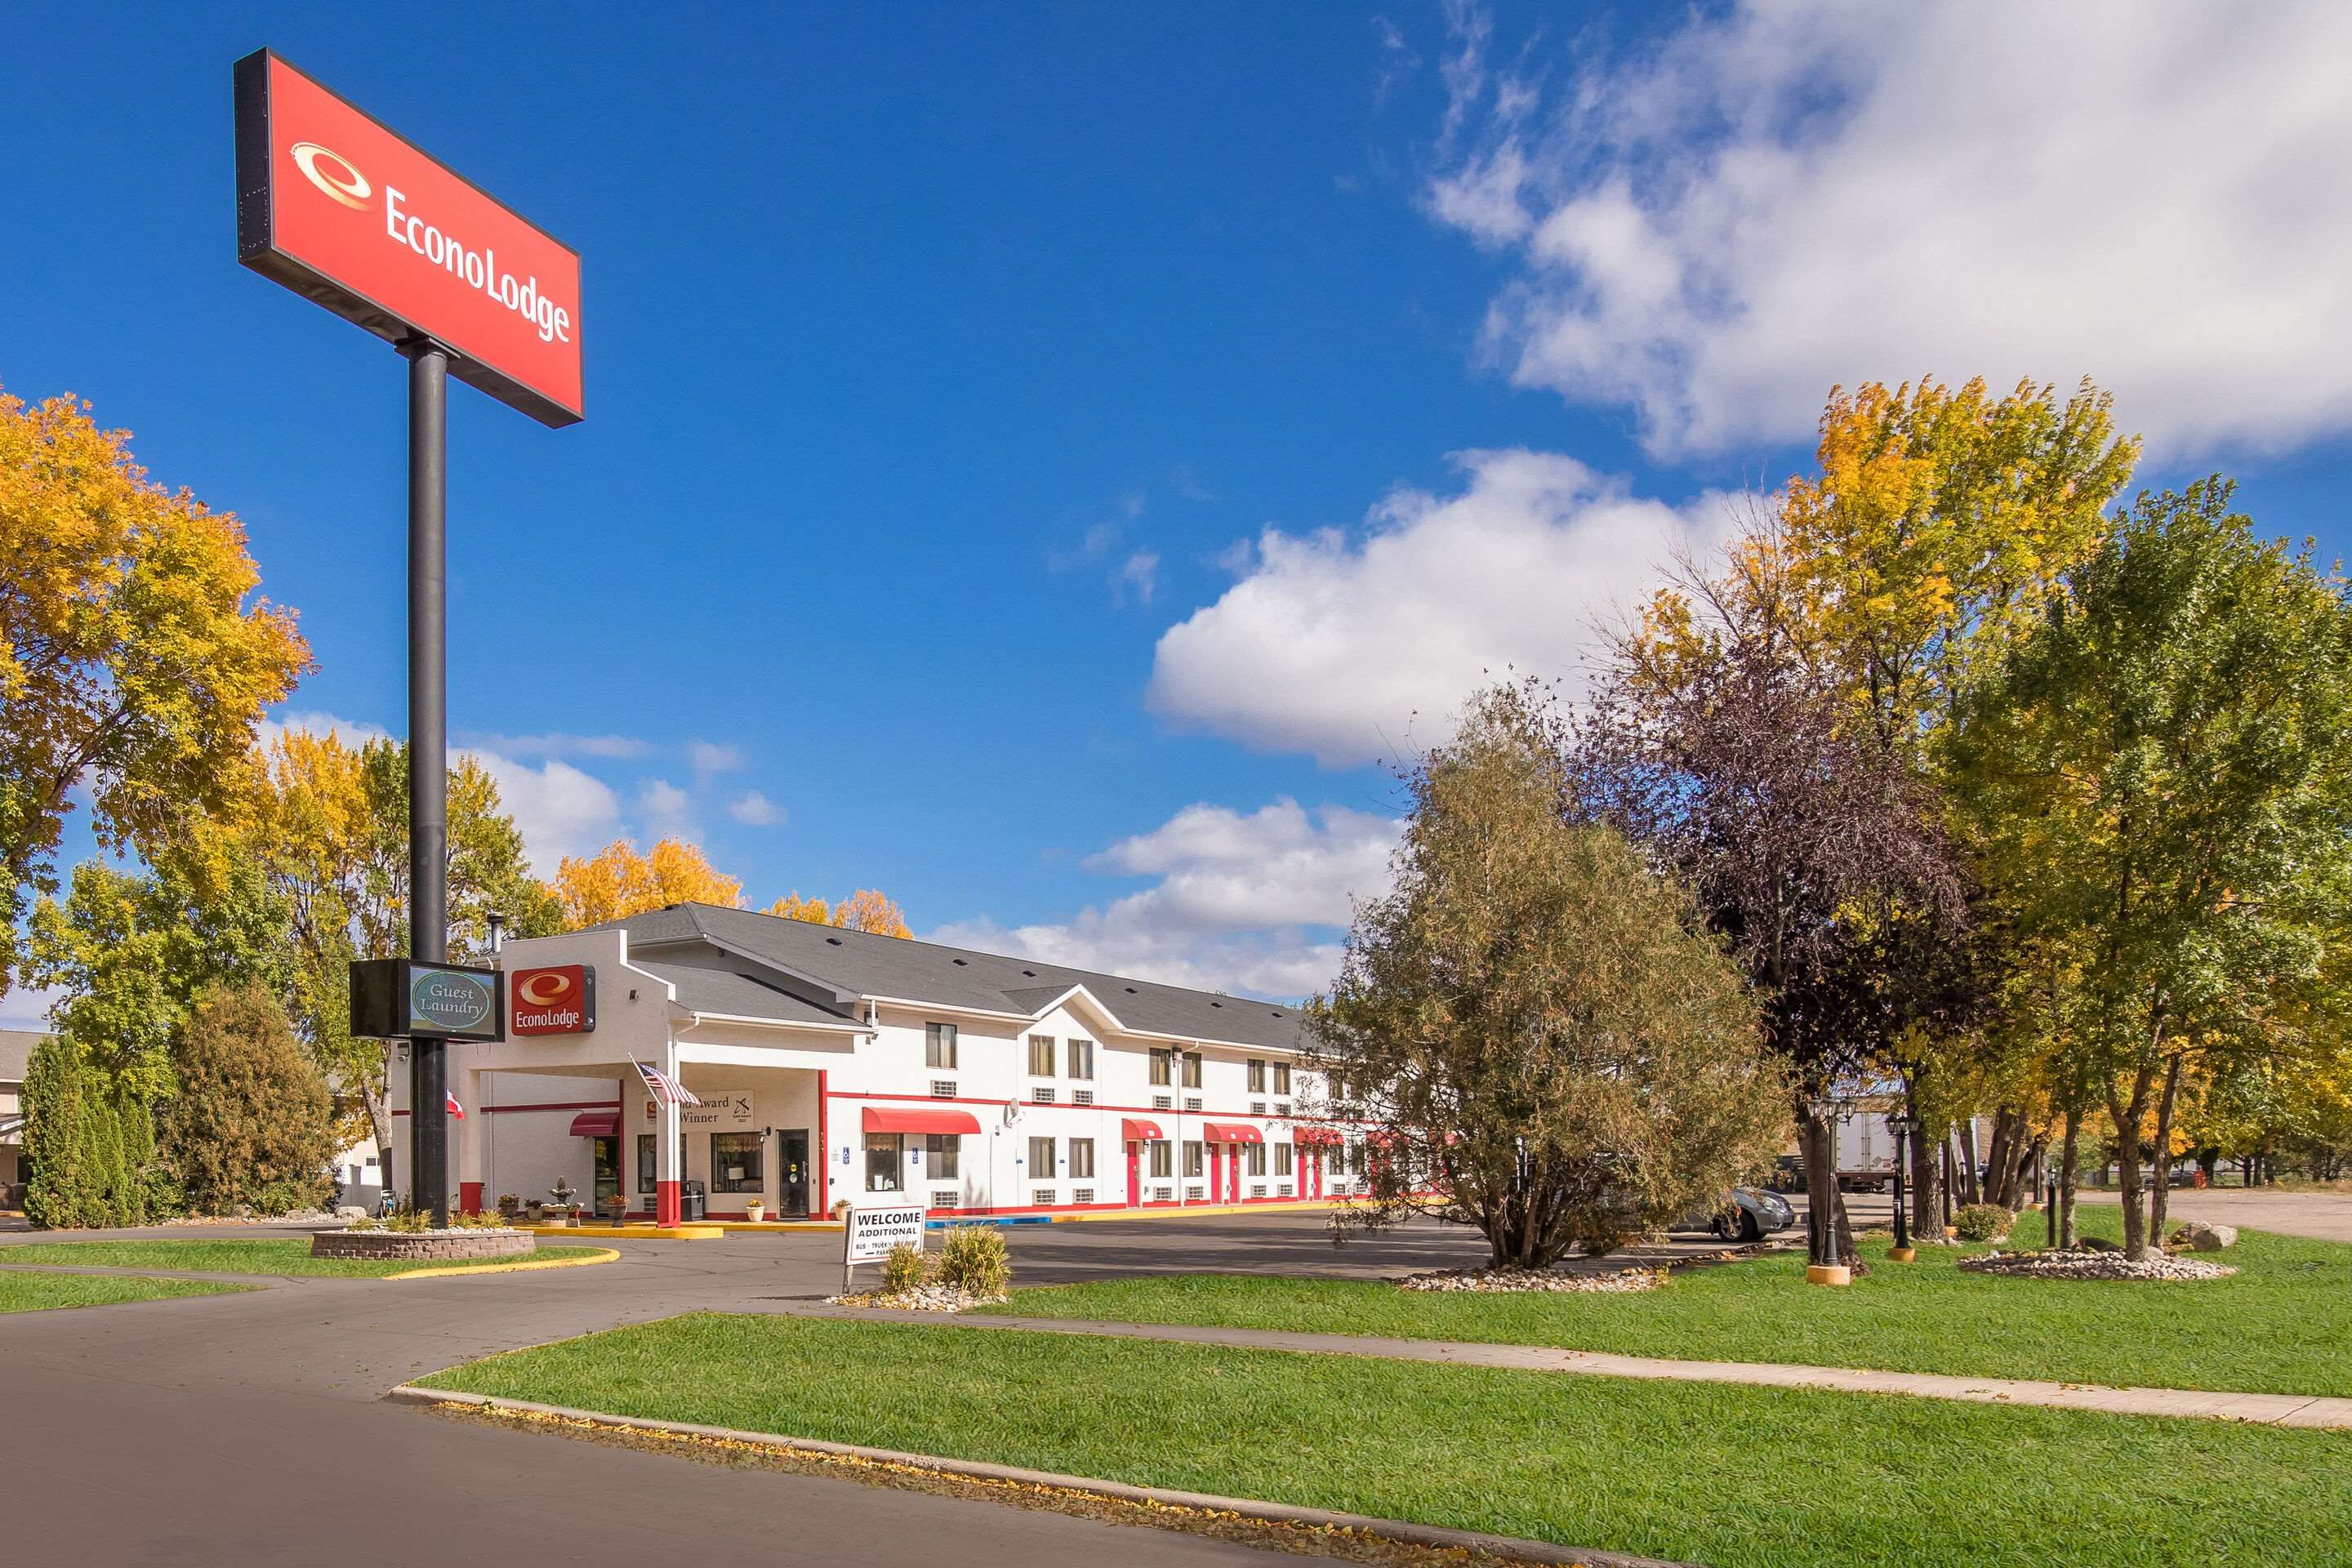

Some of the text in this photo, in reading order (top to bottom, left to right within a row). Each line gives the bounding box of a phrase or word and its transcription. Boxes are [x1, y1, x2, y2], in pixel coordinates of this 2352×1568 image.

[385, 185, 569, 344] EconoLodge
[430, 984, 474, 1000] Guest
[421, 998, 483, 1019] Laundry
[516, 1008, 579, 1028] EconoLodge
[697, 1097, 729, 1108] Award
[679, 1111, 719, 1123] Winner
[858, 1212, 921, 1226] WELCOME
[858, 1227, 917, 1237] ADDITIONAL
